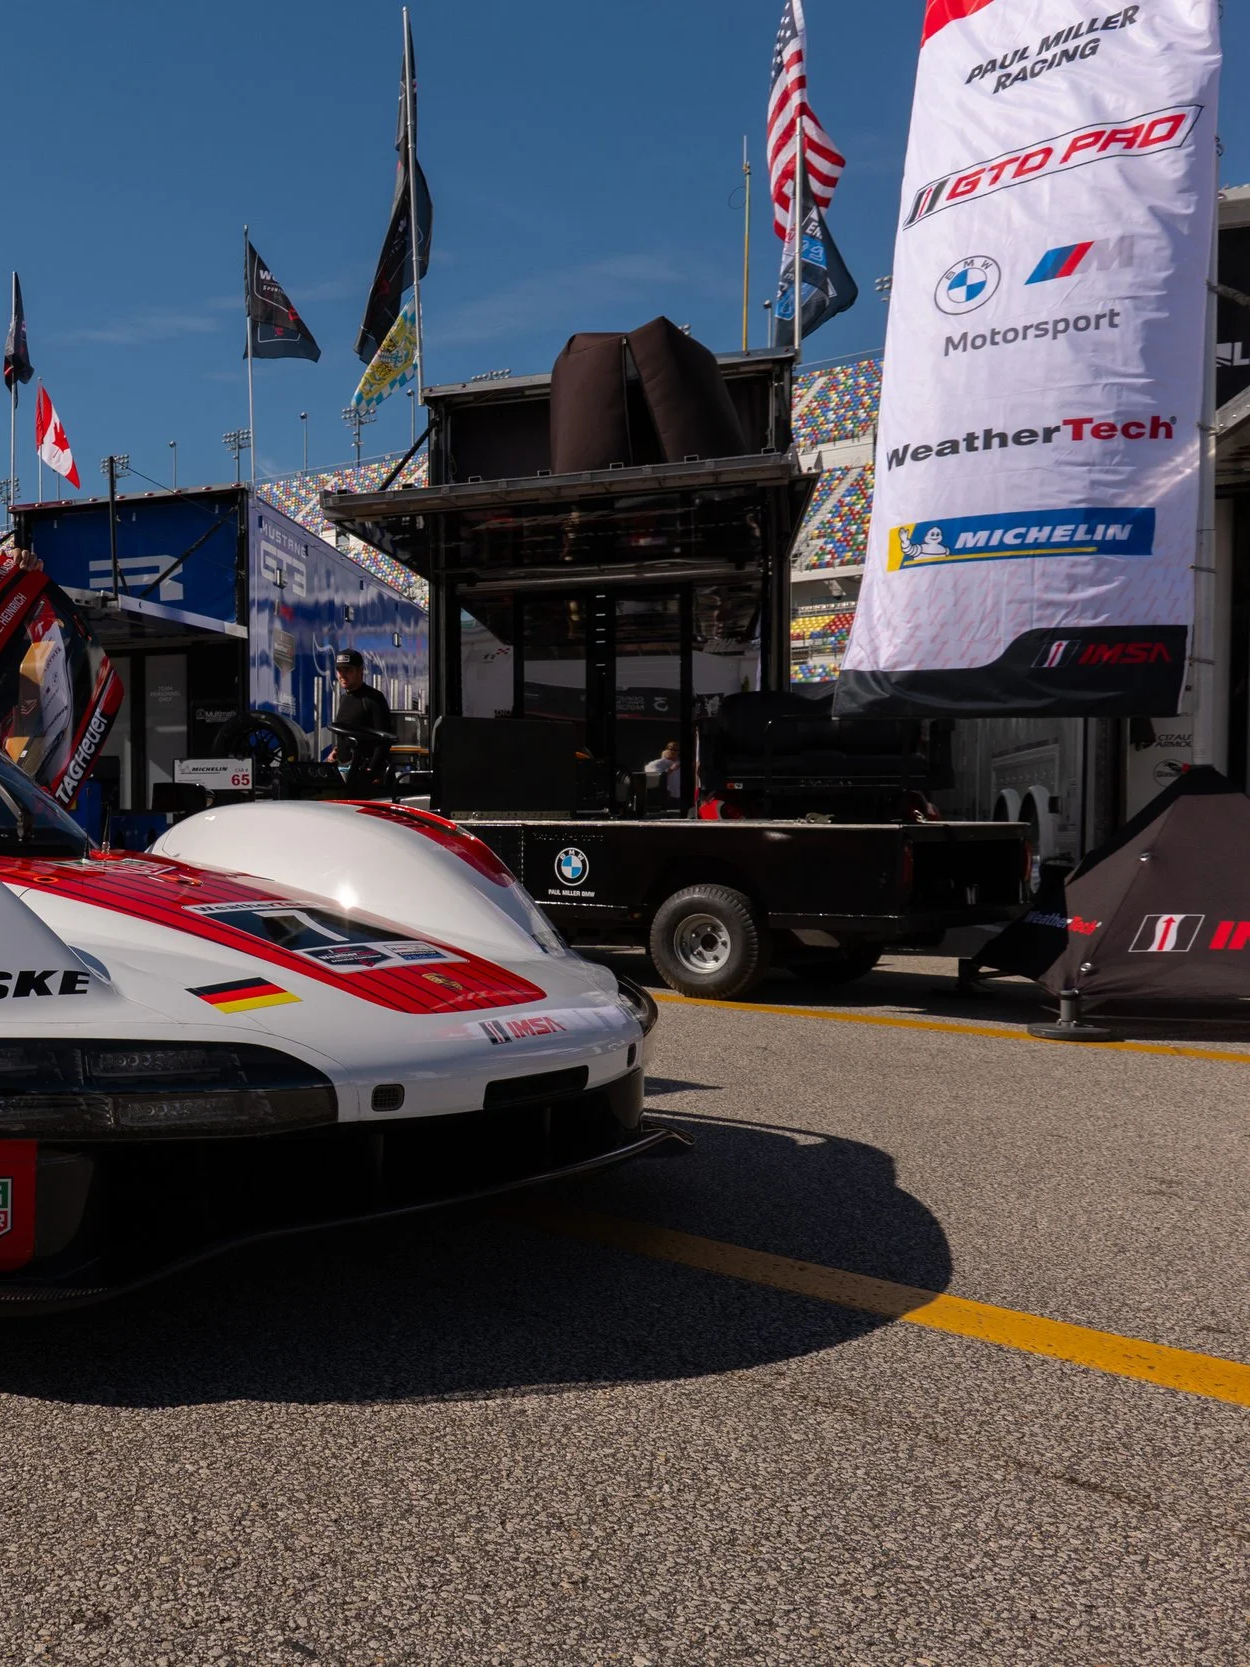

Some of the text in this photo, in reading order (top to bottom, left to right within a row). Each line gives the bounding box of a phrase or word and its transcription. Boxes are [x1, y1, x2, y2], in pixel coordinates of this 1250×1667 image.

[964, 4, 1141, 85] PAUL MILLER
[992, 37, 1102, 95] RACING
[946, 113, 1187, 202] GTD PRO
[944, 257, 993, 281] BMW
[943, 308, 1120, 357] Motorsport
[886, 416, 1174, 471] WeatherTech
[260, 519, 307, 560] MUSTANG
[955, 523, 1133, 549] MICHELIN
[260, 540, 306, 597] GT3
[1078, 642, 1171, 665] IMSA
[55, 706, 108, 804] TAGHeuer
[232, 774, 250, 786] 65
[562, 889, 581, 897] MILLER
[251, 910, 349, 941] 7
[508, 1016, 566, 1039] IMSA
